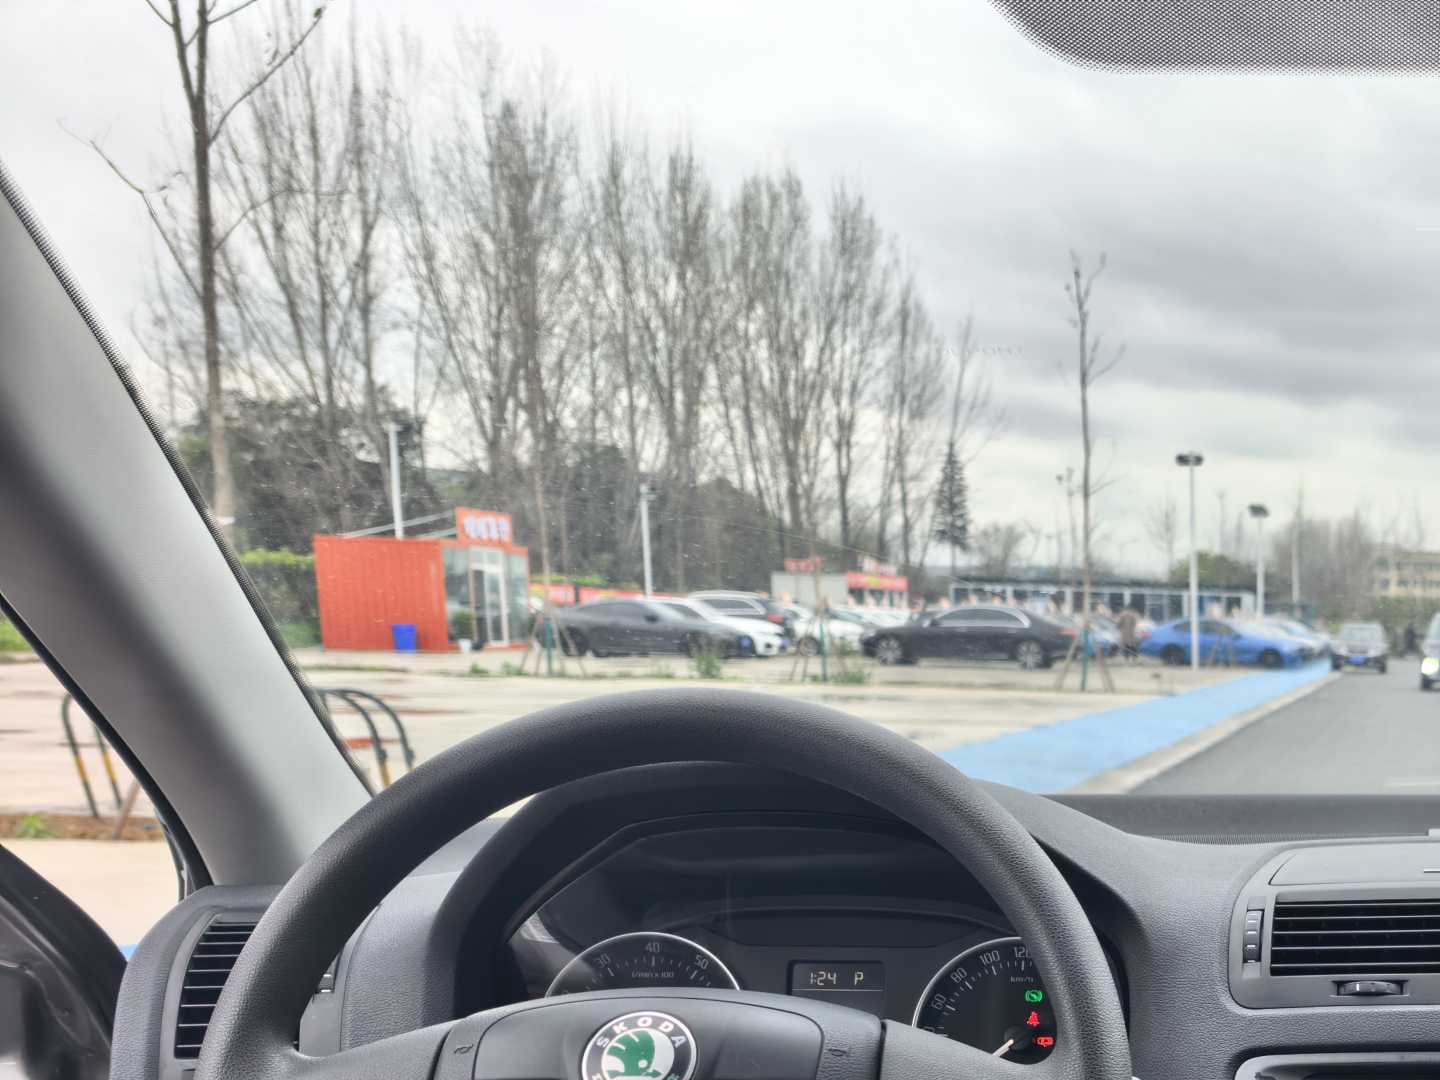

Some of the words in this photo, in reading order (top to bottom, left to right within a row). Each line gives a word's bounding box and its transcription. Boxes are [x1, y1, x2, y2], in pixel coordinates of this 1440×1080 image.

[645, 942, 660, 953] 40
[695, 954, 709, 970] 50
[810, 971, 837, 986] 1:24
[854, 972, 864, 986] P
[950, 967, 969, 984] 80
[930, 994, 946, 1009] 60
[596, 1016, 687, 1048] SKODA
